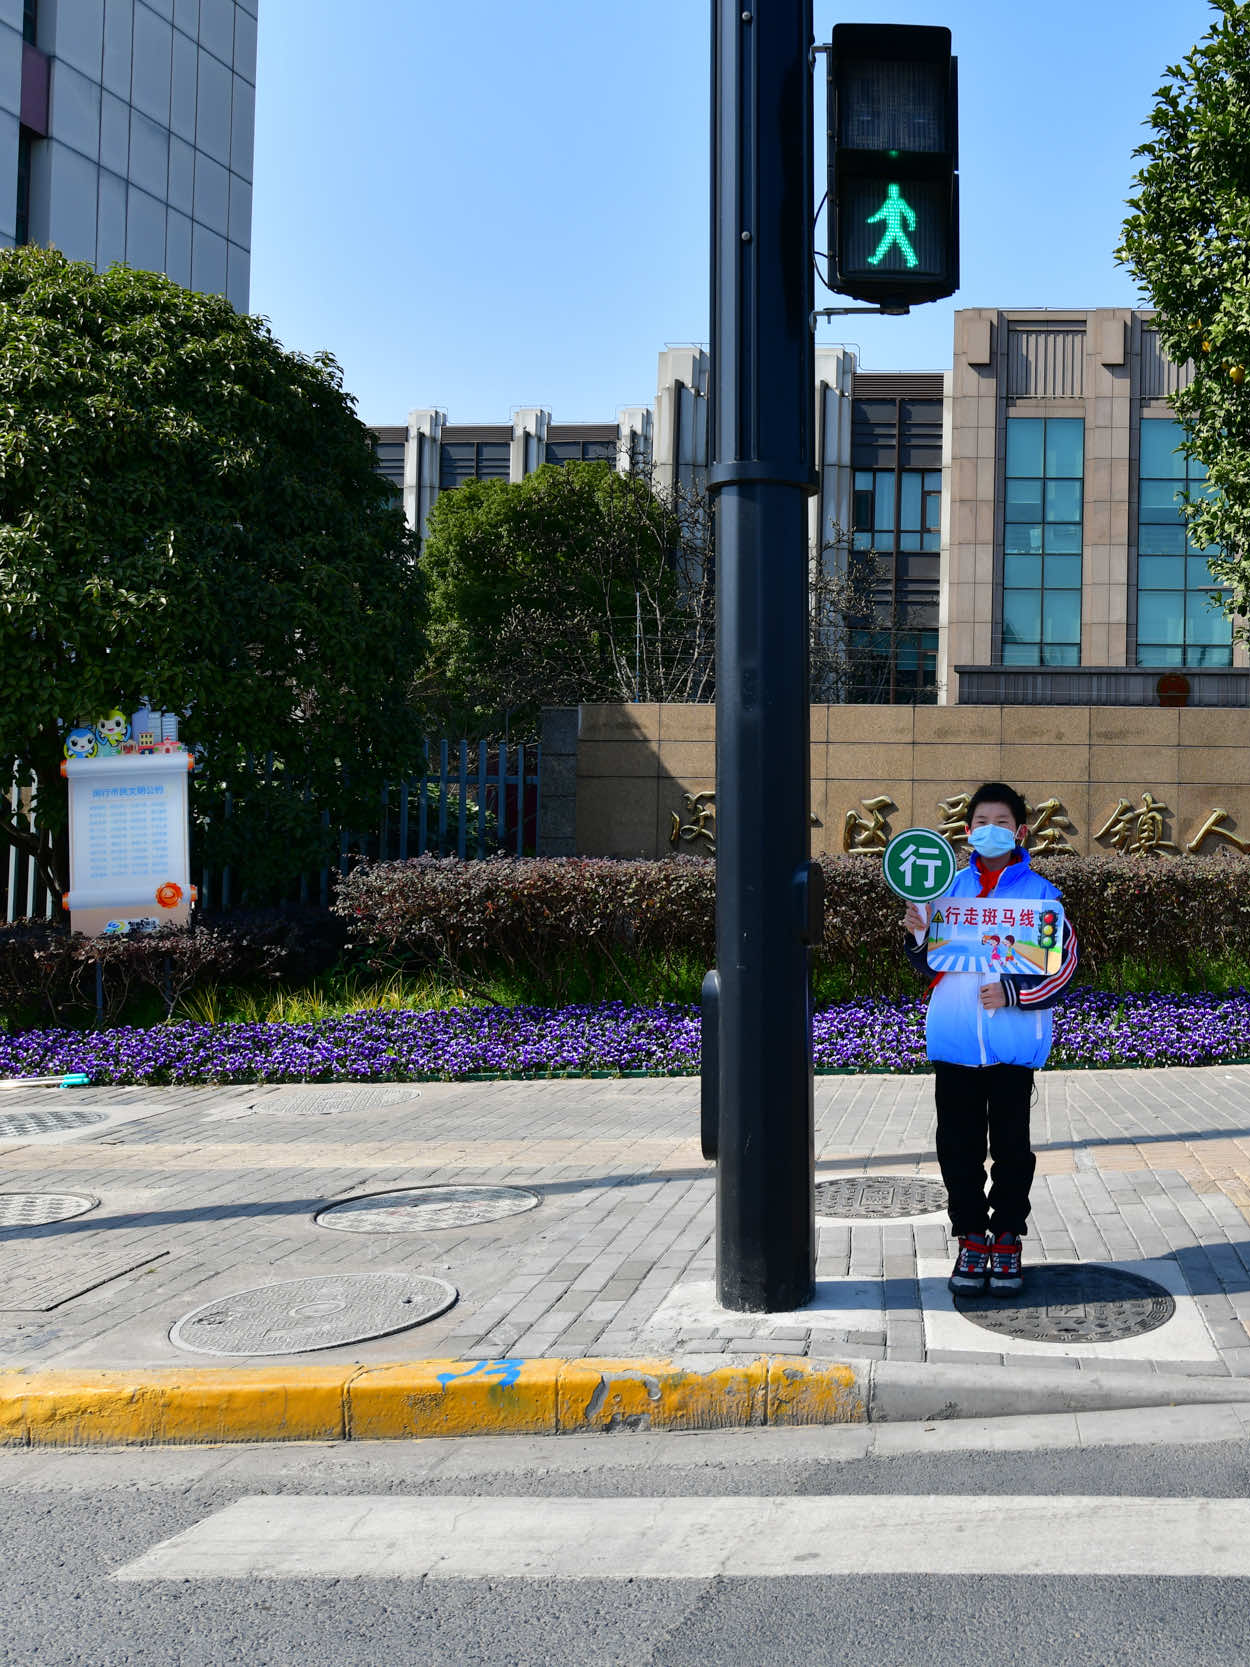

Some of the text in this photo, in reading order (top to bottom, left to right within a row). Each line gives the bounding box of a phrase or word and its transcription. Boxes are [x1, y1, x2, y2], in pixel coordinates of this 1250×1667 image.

[898, 843, 942, 889] 行
[945, 906, 1035, 928] 行走斑马线
